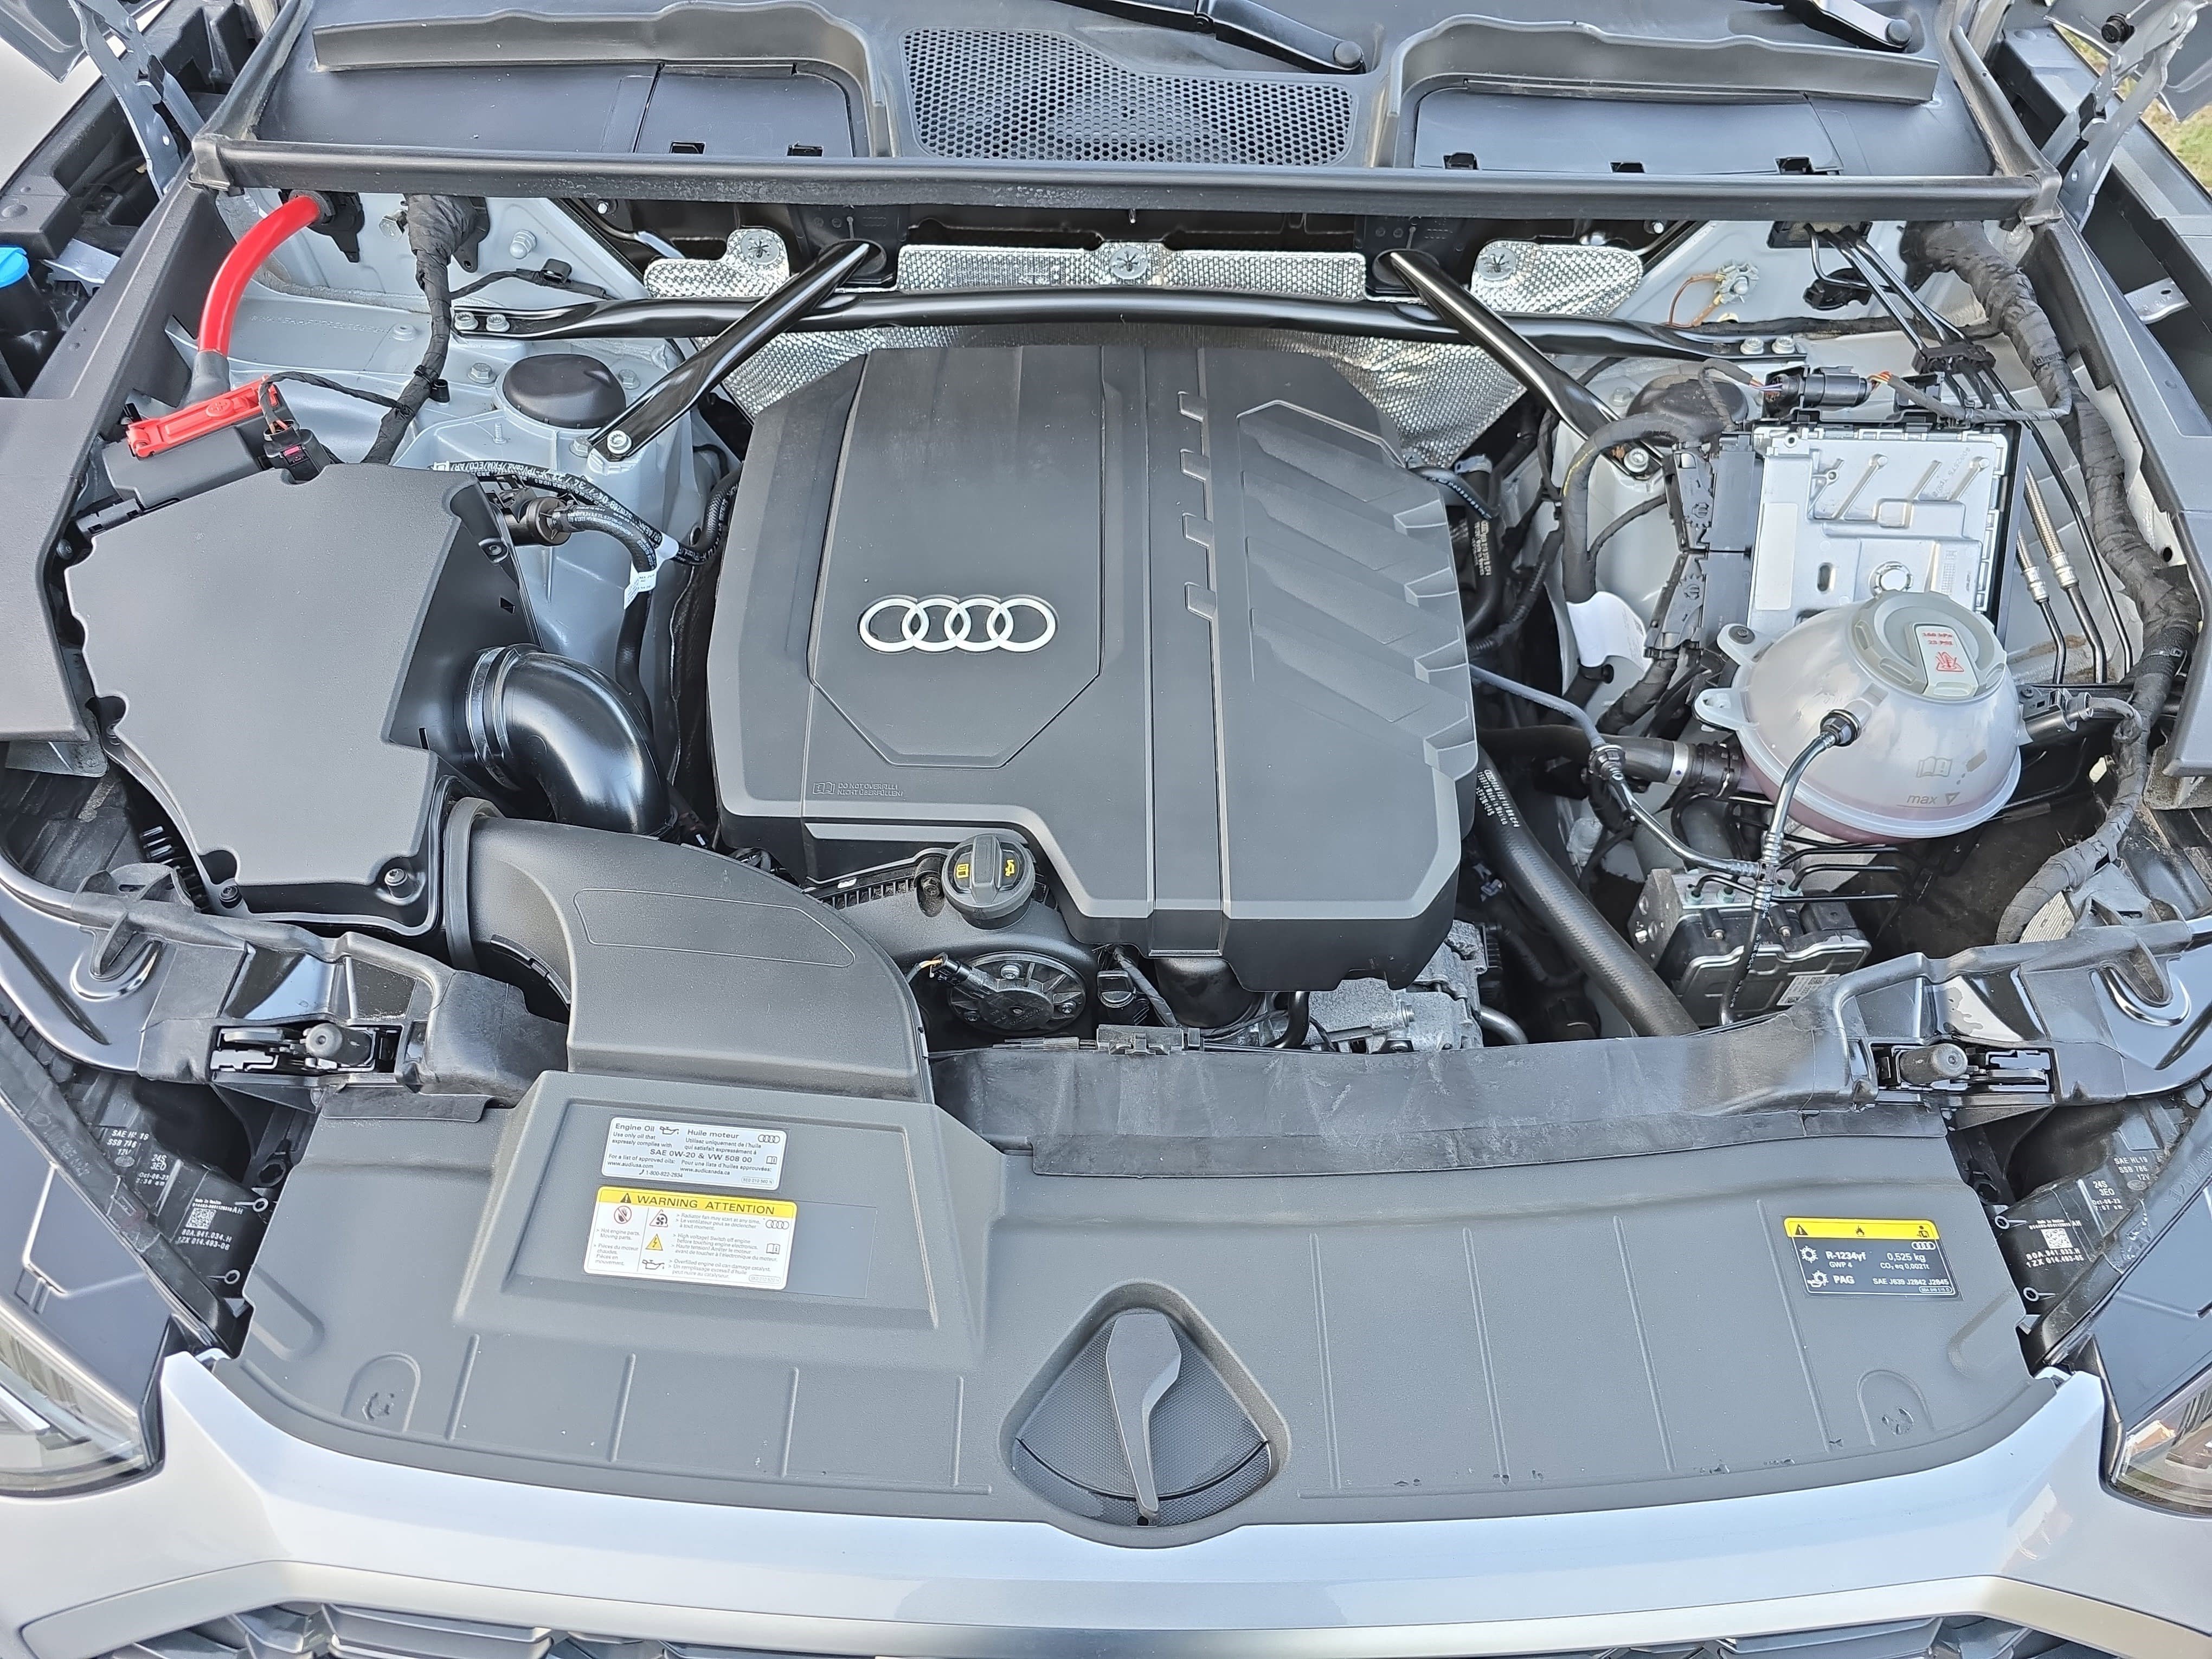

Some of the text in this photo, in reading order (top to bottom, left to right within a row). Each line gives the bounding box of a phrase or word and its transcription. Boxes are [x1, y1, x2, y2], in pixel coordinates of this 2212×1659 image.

[1907, 793, 1938, 804] max
[152, 1154, 167, 1162] 24S
[680, 1167, 730, 1175] www.audicanada.ca
[2093, 1180, 2108, 1188] 24S
[637, 1195, 775, 1214] WARNING ATTENTION
[191, 1238, 230, 1250] 014.493-06
[1825, 1251, 1866, 1262] R-1234yf
[1887, 1252, 1926, 1263] 0,525 kg
[1832, 1275, 1855, 1284] PAG
